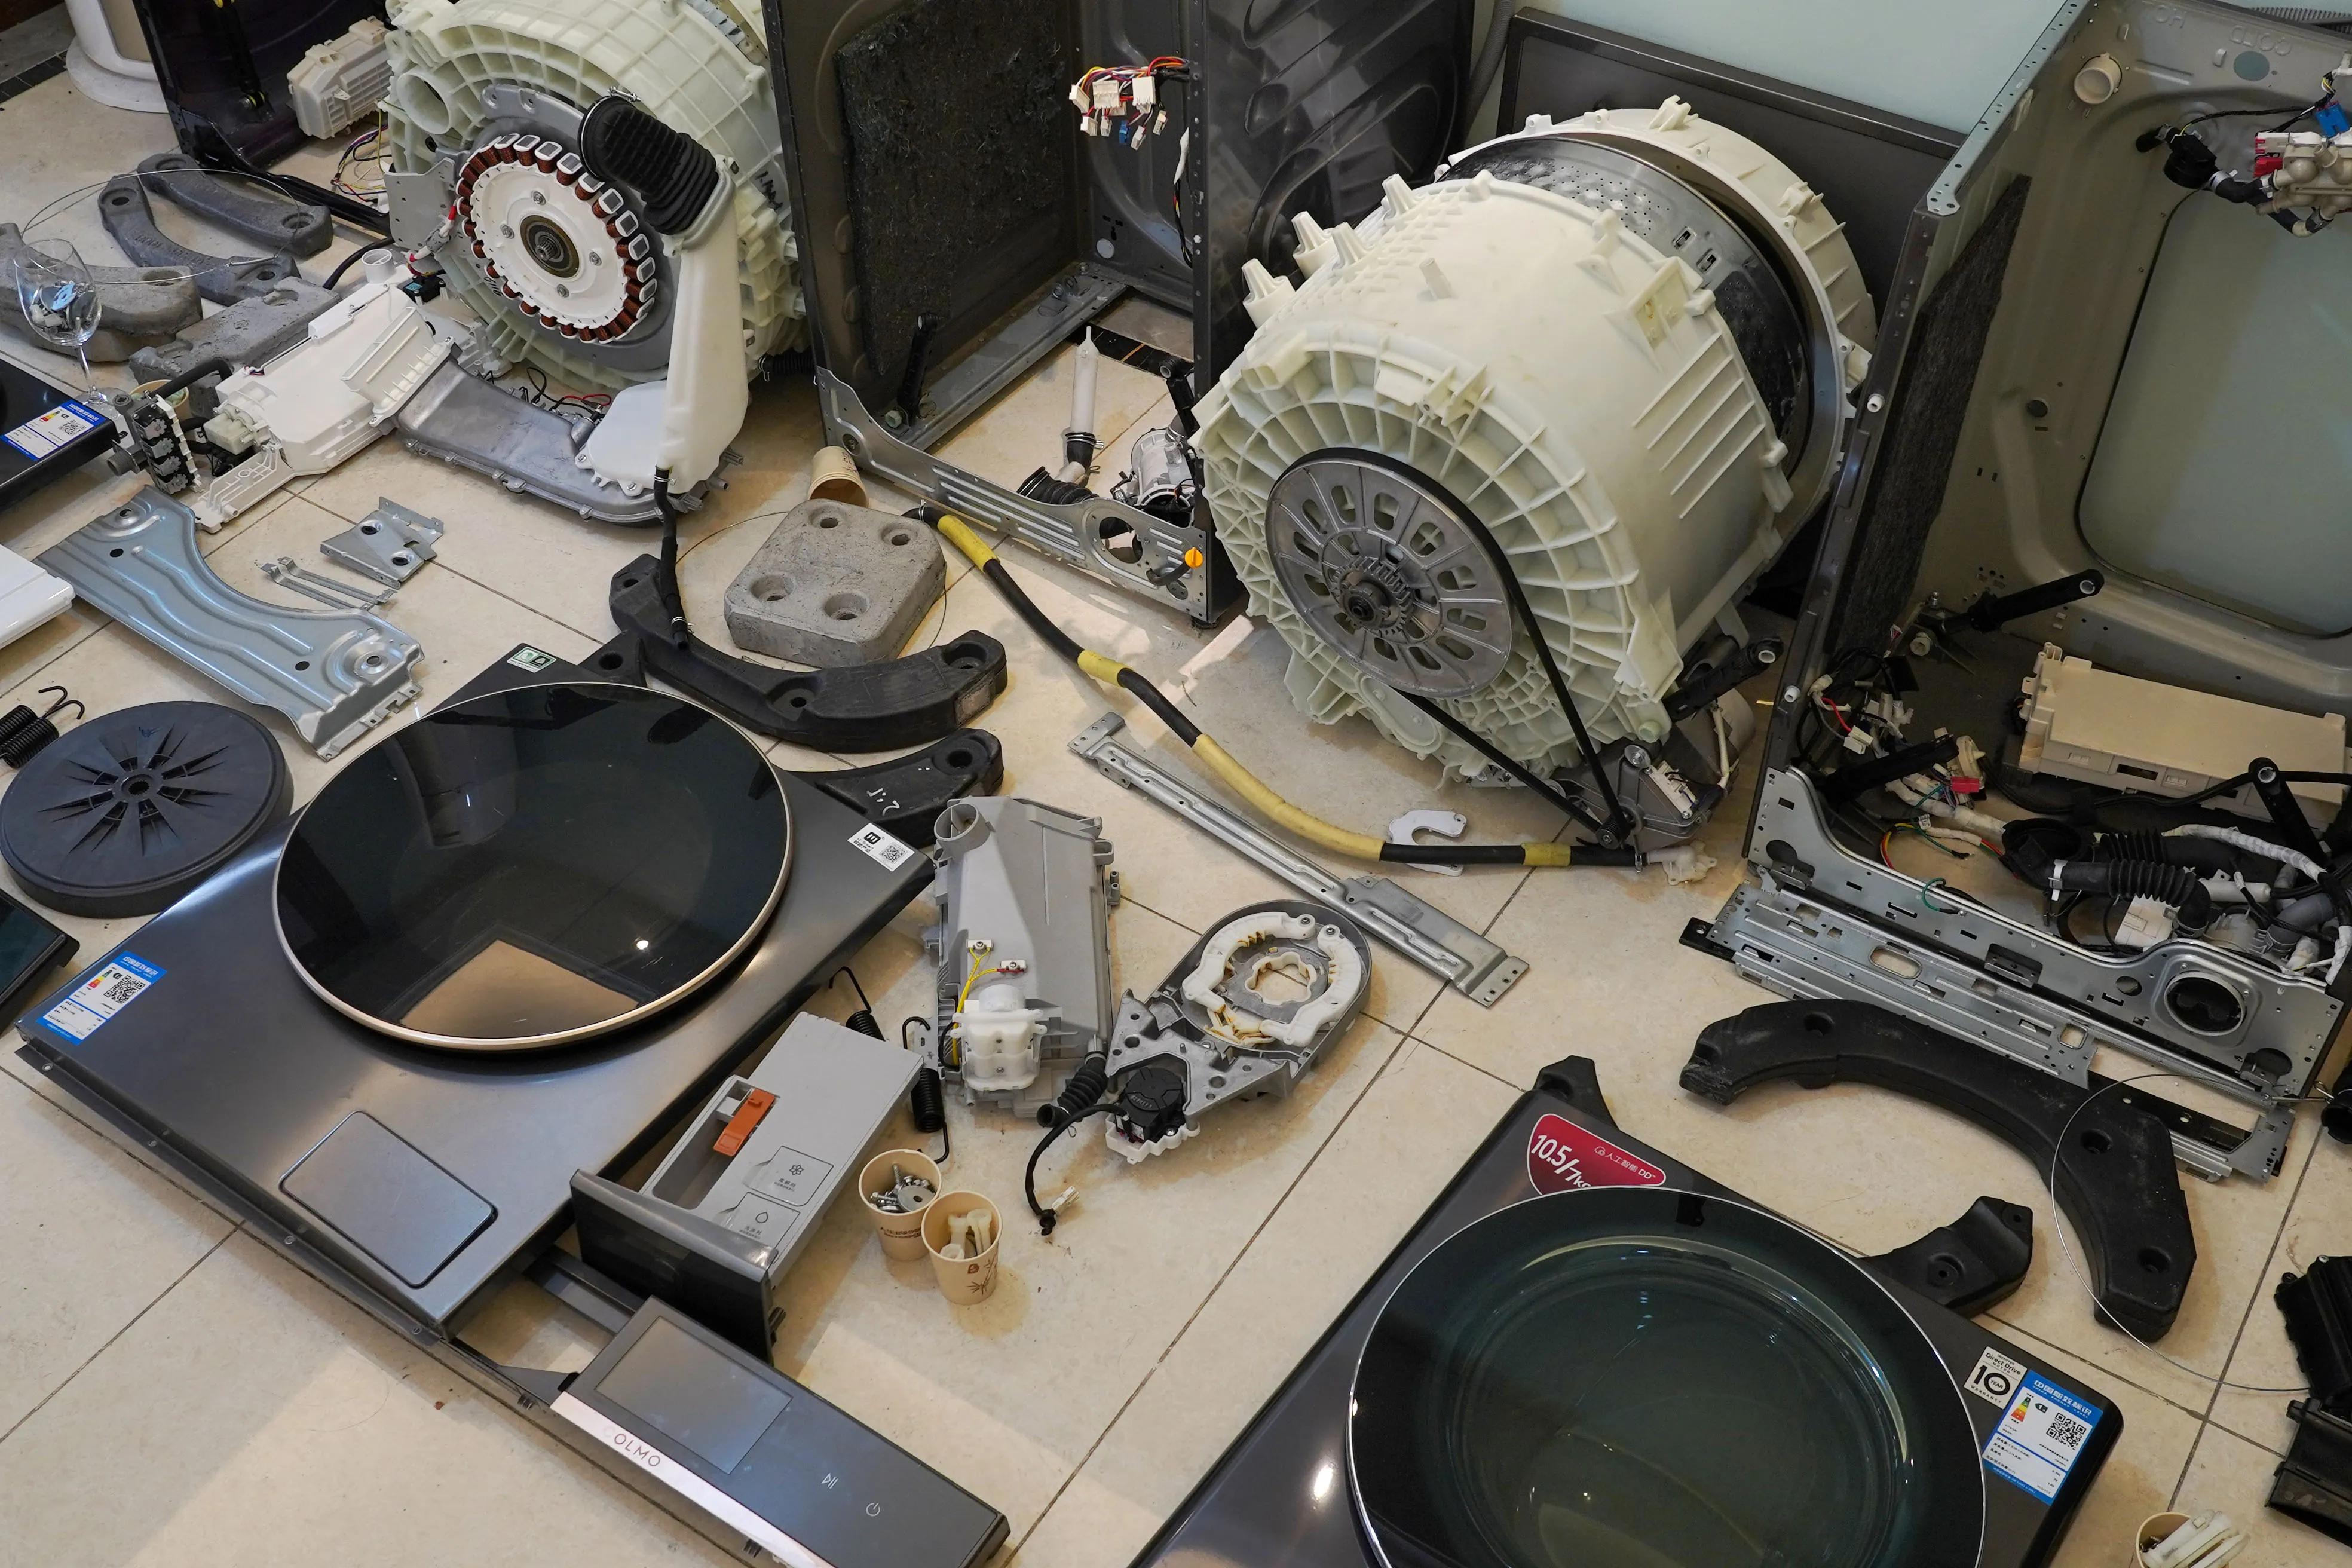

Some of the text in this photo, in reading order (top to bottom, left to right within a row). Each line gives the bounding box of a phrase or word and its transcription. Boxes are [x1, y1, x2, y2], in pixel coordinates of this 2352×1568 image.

[1604, 1153, 1639, 1173] 人工智能
[1986, 1352, 2022, 1375] Direct Drive
[1973, 1365, 2011, 1396] 10
[1990, 1379, 2004, 1389] YEAR
[1971, 1385, 2002, 1404] WARRANTY
[2034, 1379, 2093, 1416] 中国能效标识
